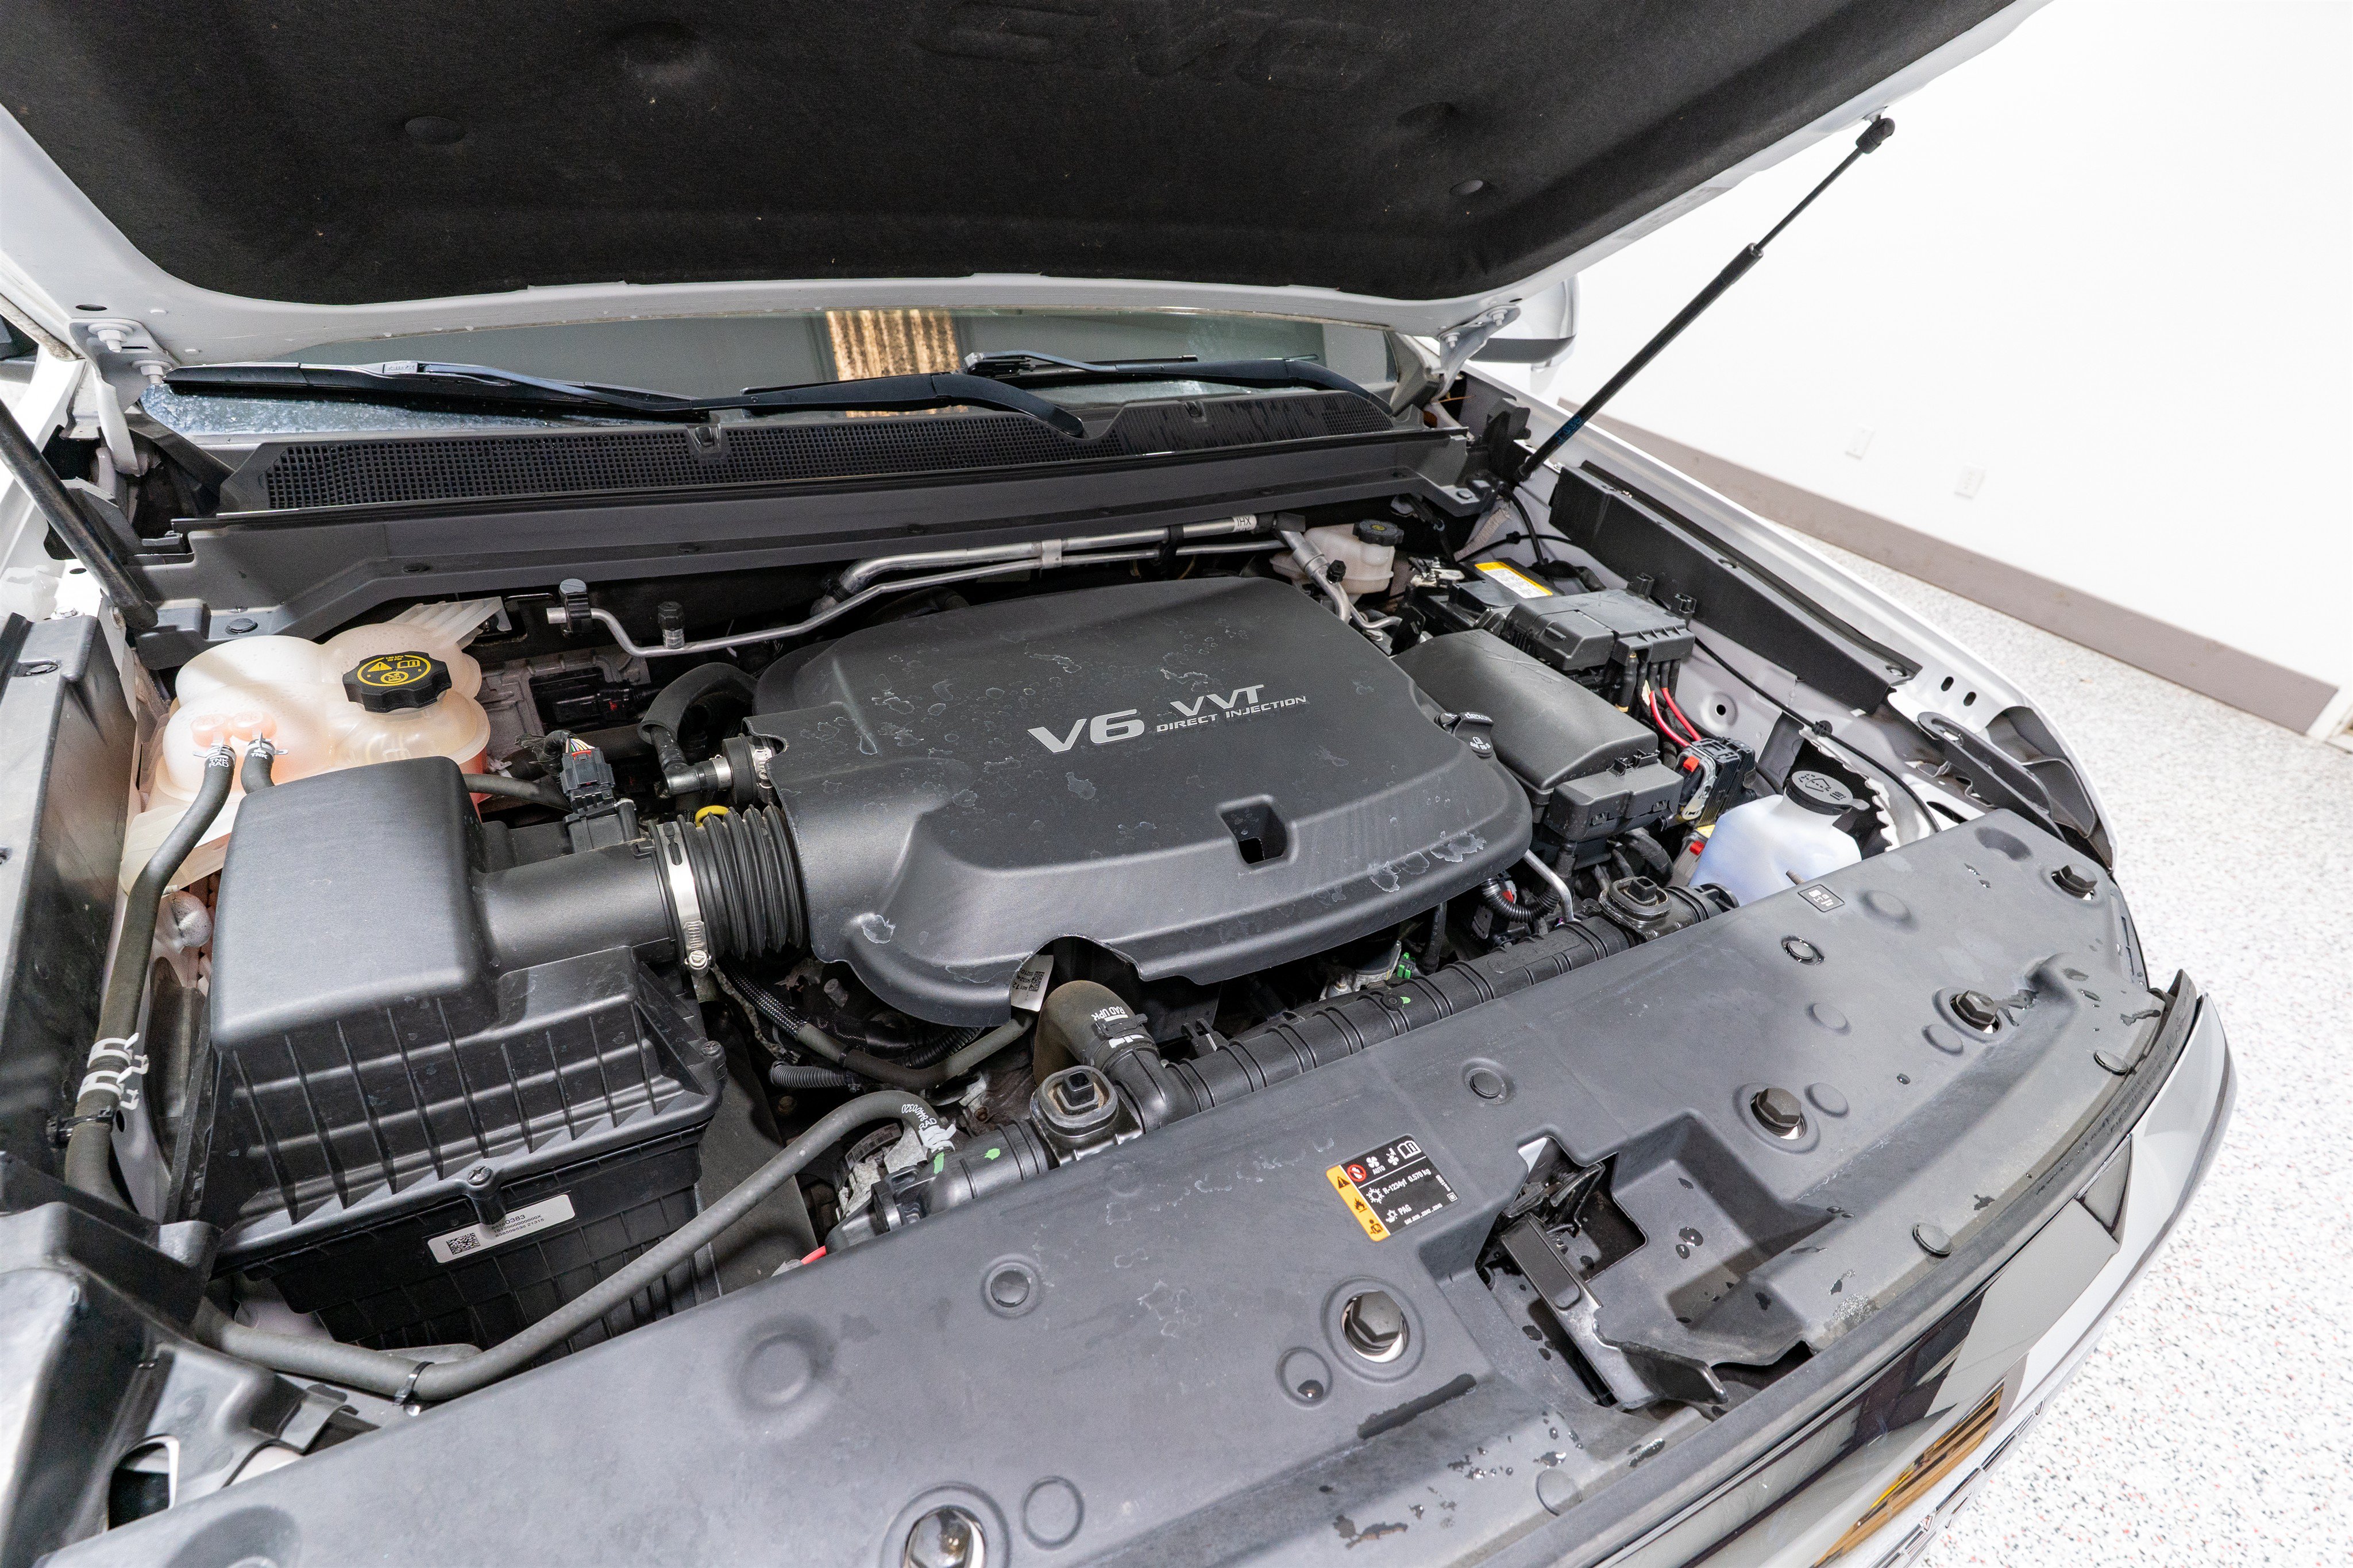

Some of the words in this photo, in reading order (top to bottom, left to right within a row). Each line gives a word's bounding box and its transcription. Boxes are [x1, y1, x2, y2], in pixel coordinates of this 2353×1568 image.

[1236, 516, 1251, 527] IHX
[1170, 683, 1264, 717] VVT
[1156, 713, 1218, 733] DIRECT
[1225, 695, 1306, 720] INJECTION
[1027, 708, 1145, 754] V6
[1091, 1009, 1111, 1021] UPR
[1108, 1006, 1126, 1015] RAD
[919, 1118, 938, 1131] RAD
[1372, 1165, 1386, 1175] AUTO
[1382, 1178, 1407, 1195] R-1234yf
[1407, 1171, 1424, 1183] 0.570
[1398, 1204, 1413, 1215] PAG
